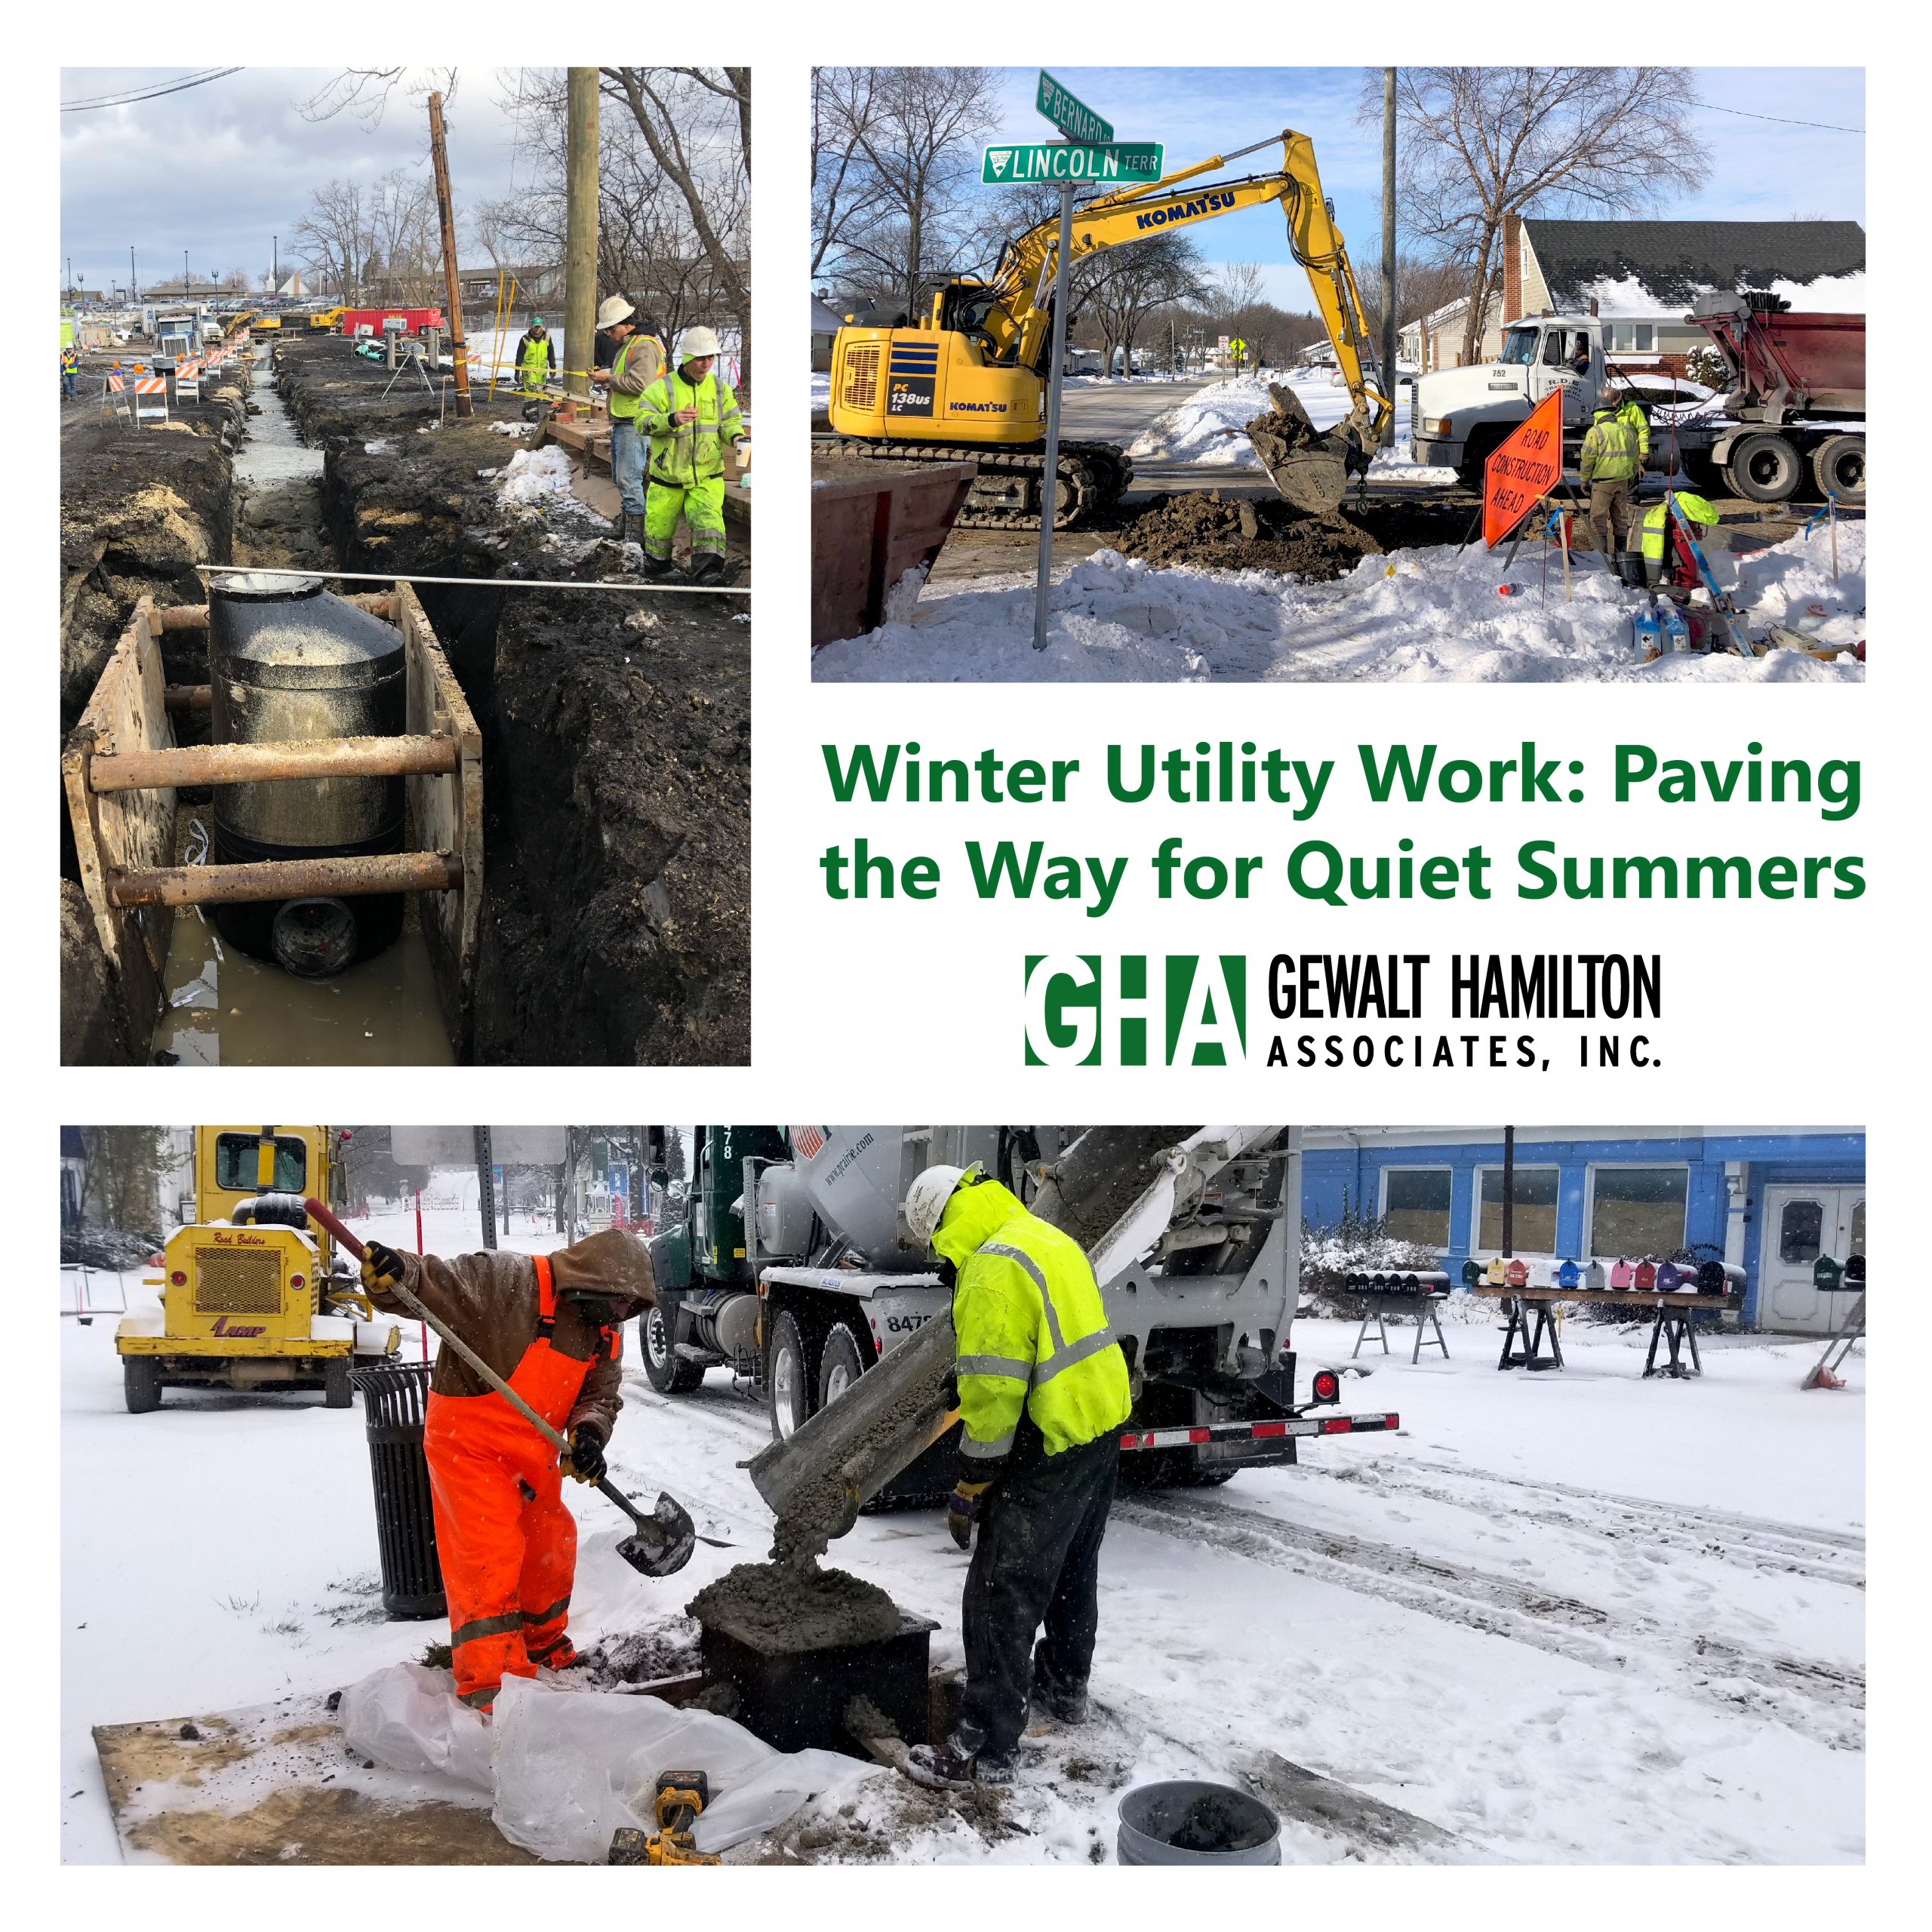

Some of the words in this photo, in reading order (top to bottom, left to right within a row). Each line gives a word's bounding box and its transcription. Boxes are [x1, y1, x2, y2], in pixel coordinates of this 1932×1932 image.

[1054, 88, 1102, 141] BERNARD
[1013, 149, 1118, 177] LINCOLN
[1125, 155, 1157, 170] TERR
[1137, 192, 1235, 229] KOMATSU
[894, 383, 909, 392] PC
[950, 401, 1007, 412] KOMATSU
[1521, 429, 1549, 450] ROAD
[1491, 454, 1555, 486] CONSTRUCTION
[1491, 488, 1524, 513] AHEAD
[825, 1133, 874, 1186] www.prairie.com
[214, 1232, 232, 1244] Road
[237, 1233, 265, 1245] Builders
